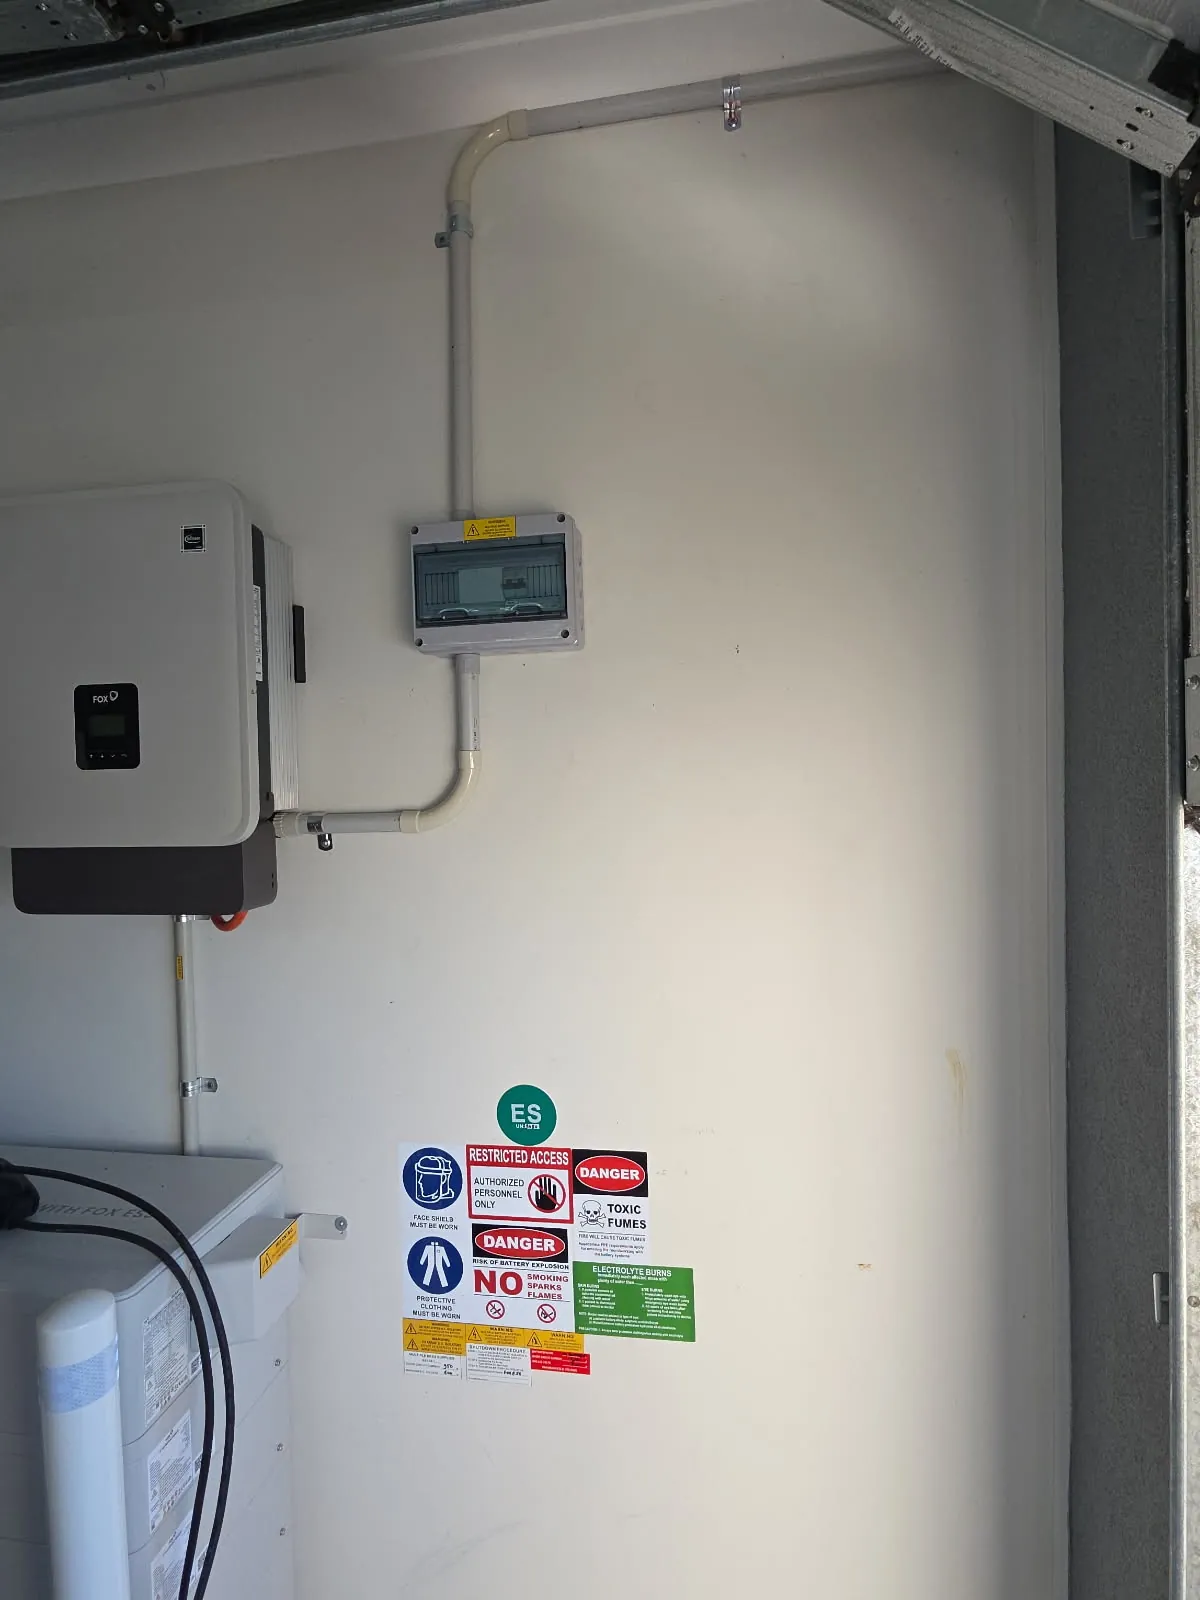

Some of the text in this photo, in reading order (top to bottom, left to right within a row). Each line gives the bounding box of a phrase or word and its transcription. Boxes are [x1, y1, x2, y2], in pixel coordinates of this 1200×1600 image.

[92, 695, 109, 703] FOX
[510, 1103, 542, 1123] ES
[469, 1148, 569, 1165] RESTRICTED ACCESS
[580, 1167, 640, 1180] DANGER
[474, 1177, 524, 1187] AUTHORIZED
[474, 1189, 523, 1198] PERSONNEL
[474, 1200, 496, 1209] ONLY
[607, 1204, 641, 1214] TOXIC
[80, 1206, 121, 1217] FOX
[608, 1218, 647, 1229] FUMES
[483, 1235, 556, 1252] DANGER
[531, 1262, 569, 1270] EXPLOSION
[592, 1266, 672, 1277] ELECTROLYTE BURNS
[474, 1269, 523, 1295] NO
[527, 1273, 569, 1282] SMOKING
[527, 1282, 562, 1290] SPARKS
[416, 1296, 456, 1304] PROTECTIVE
[527, 1291, 563, 1300] FLAMES
